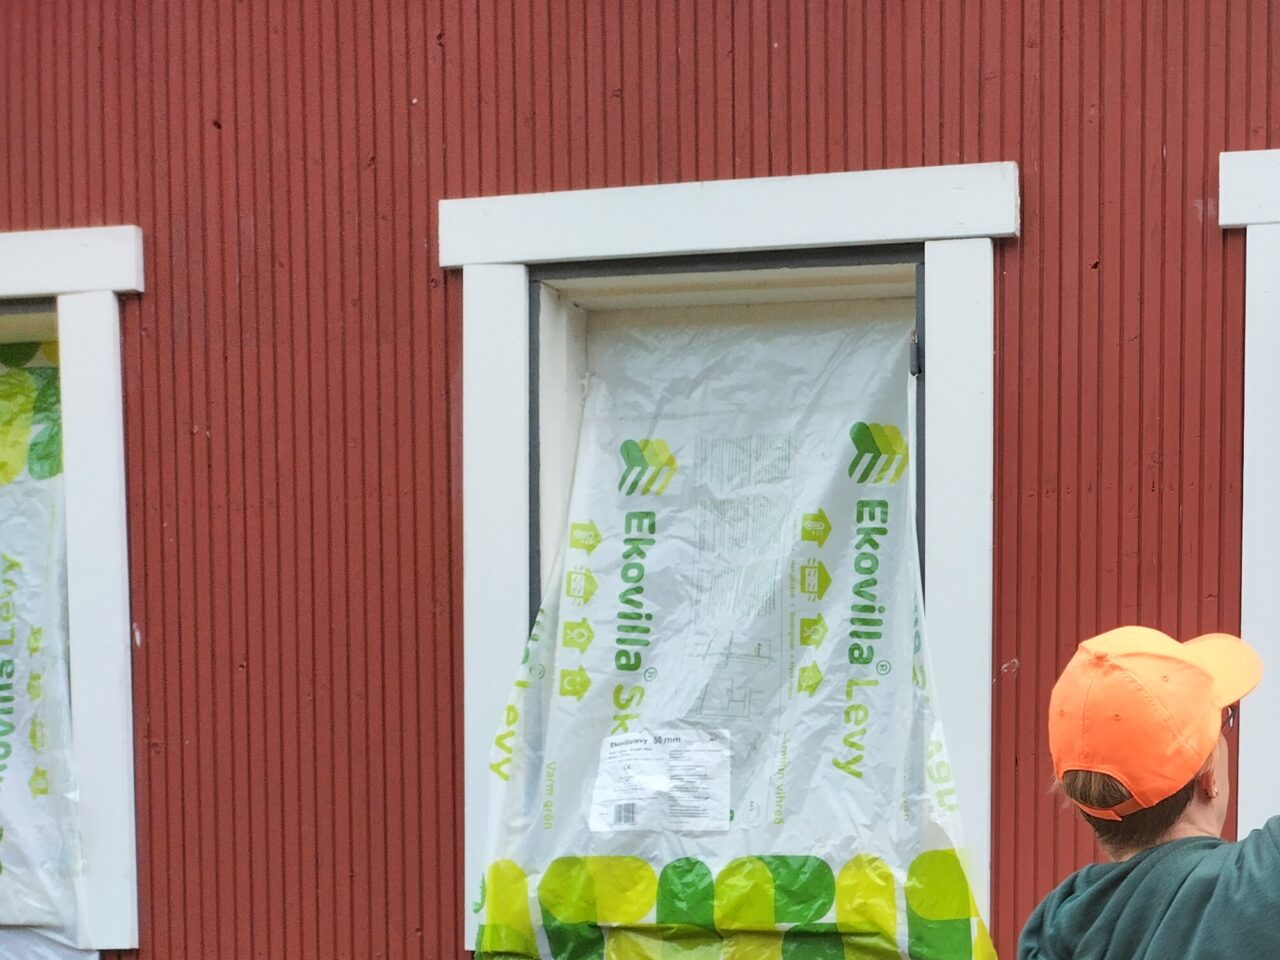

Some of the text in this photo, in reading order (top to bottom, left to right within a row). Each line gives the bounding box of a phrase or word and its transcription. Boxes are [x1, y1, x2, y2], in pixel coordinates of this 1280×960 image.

[611, 683, 645, 735] Sk
[831, 679, 879, 779] Levy
[653, 736, 663, 745] 50
[545, 760, 557, 796] Varm
